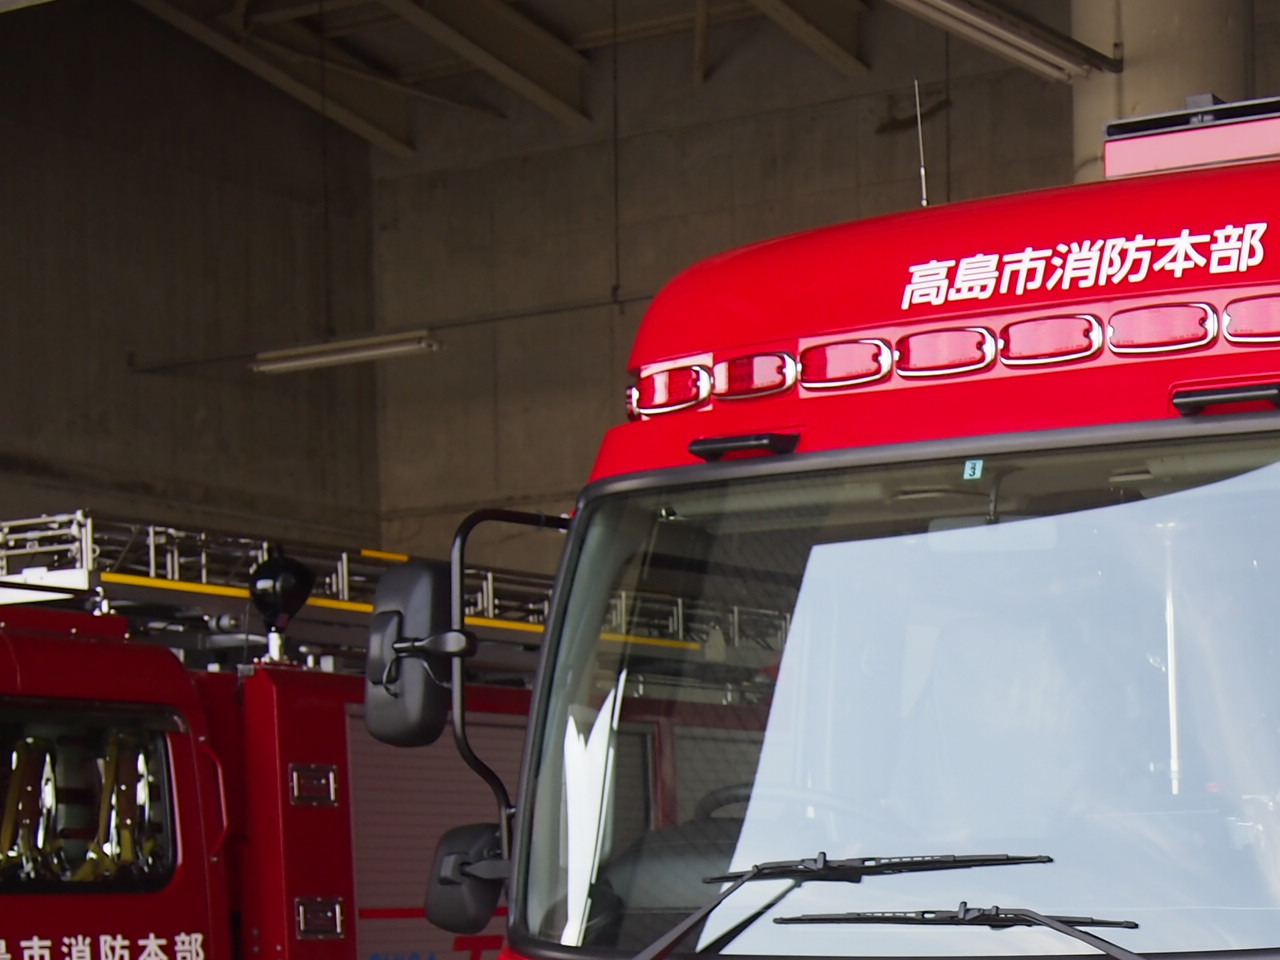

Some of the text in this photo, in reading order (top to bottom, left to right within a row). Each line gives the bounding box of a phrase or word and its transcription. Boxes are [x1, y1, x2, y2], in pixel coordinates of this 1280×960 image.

[902, 222, 1268, 310] 高島市消防本部
